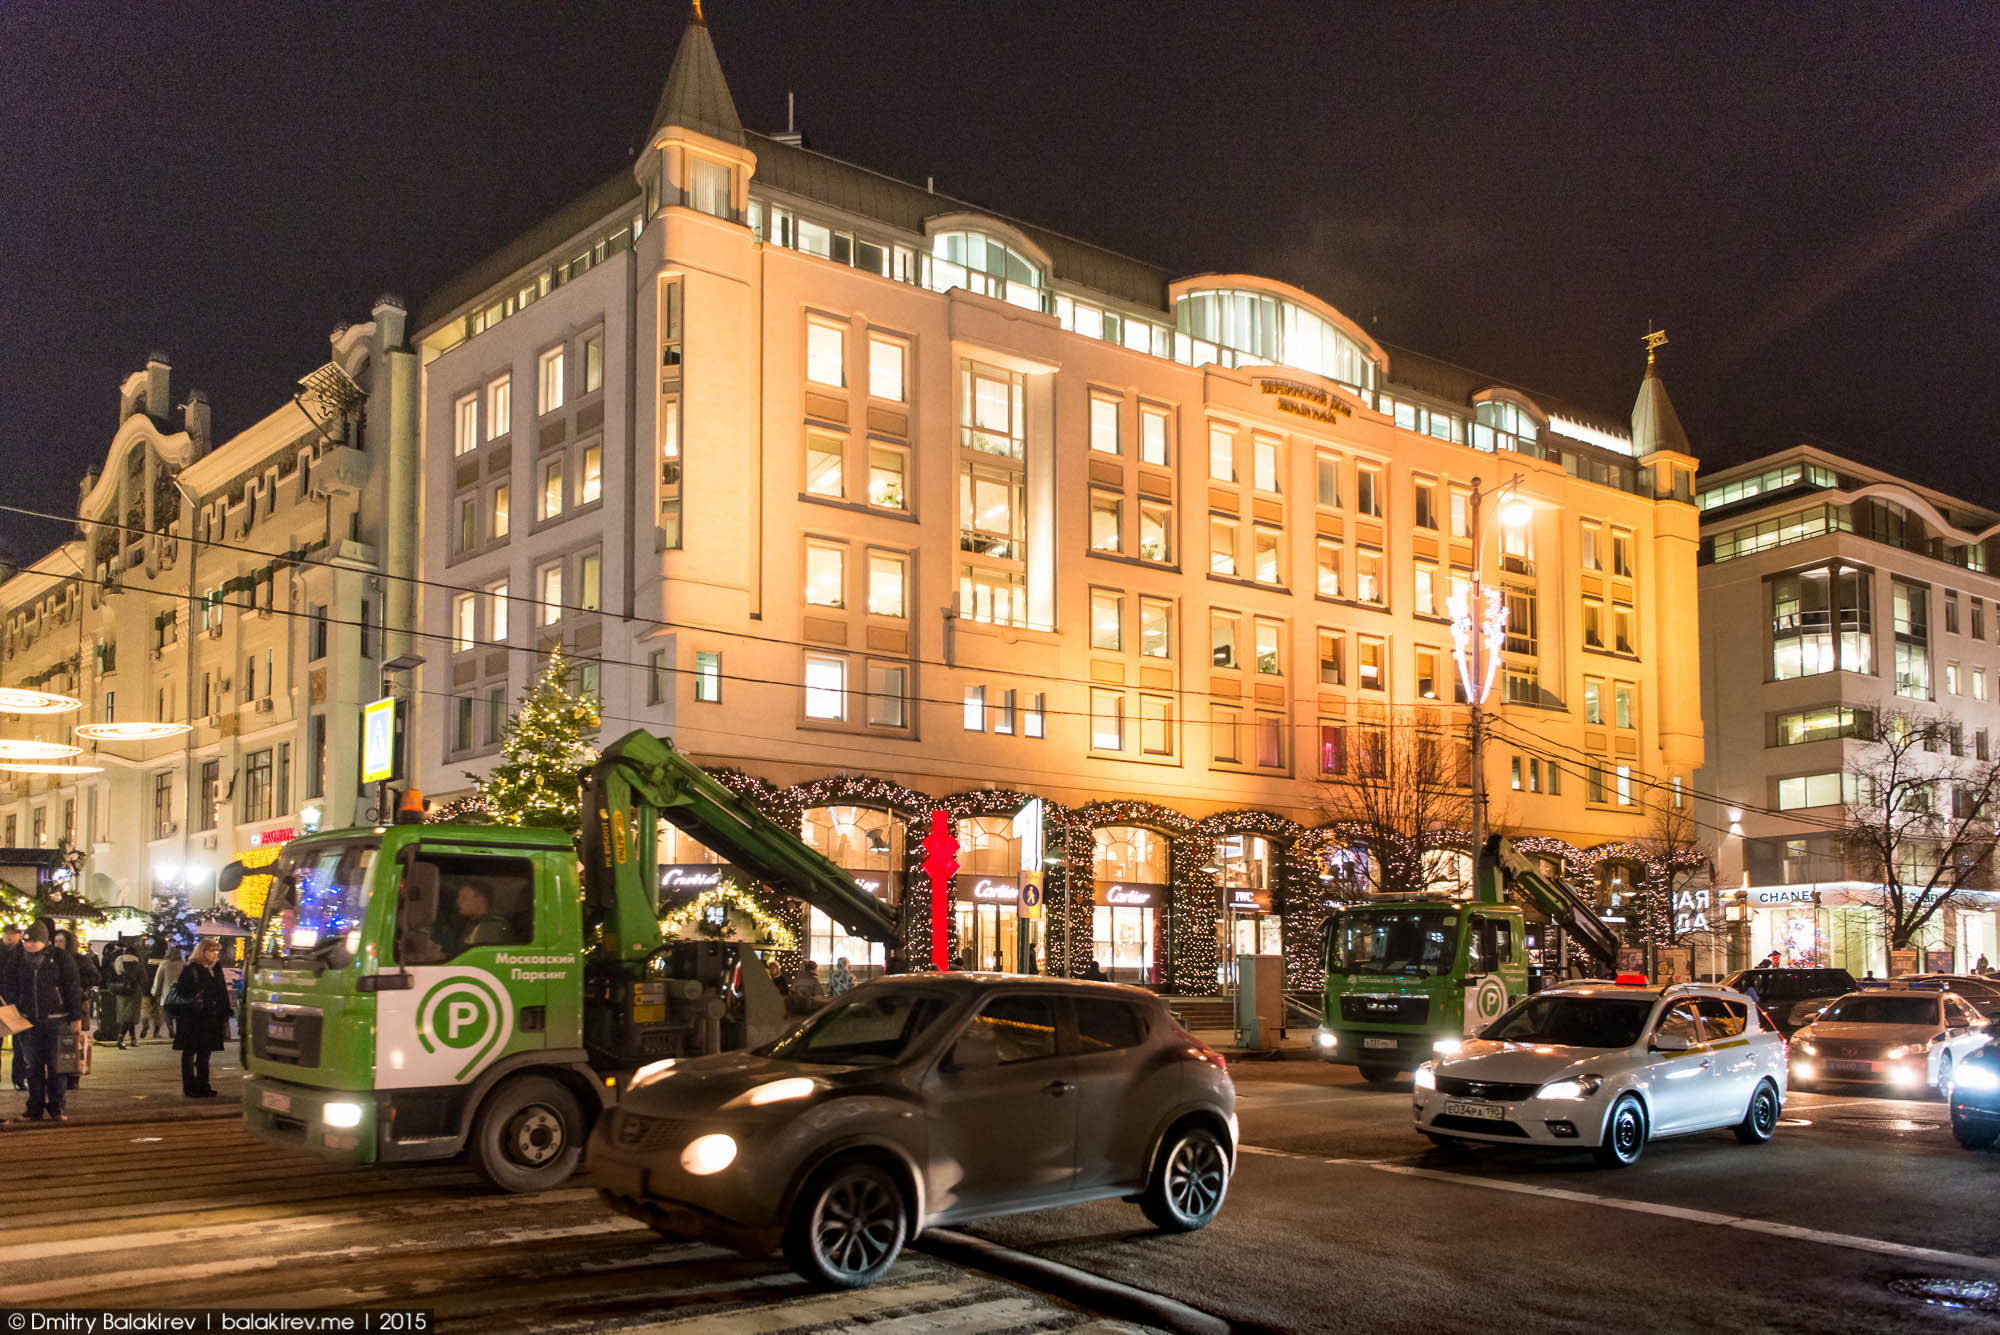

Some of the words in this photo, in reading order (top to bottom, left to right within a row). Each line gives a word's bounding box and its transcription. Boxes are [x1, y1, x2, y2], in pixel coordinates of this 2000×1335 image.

[1106, 885, 1151, 903] Cartier
[1234, 891, 1254, 903] IWC
[1759, 890, 1810, 903] CHANE
[495, 952, 575, 964] Московский
[511, 968, 566, 983] Паркинг
[447, 1001, 479, 1039] P
